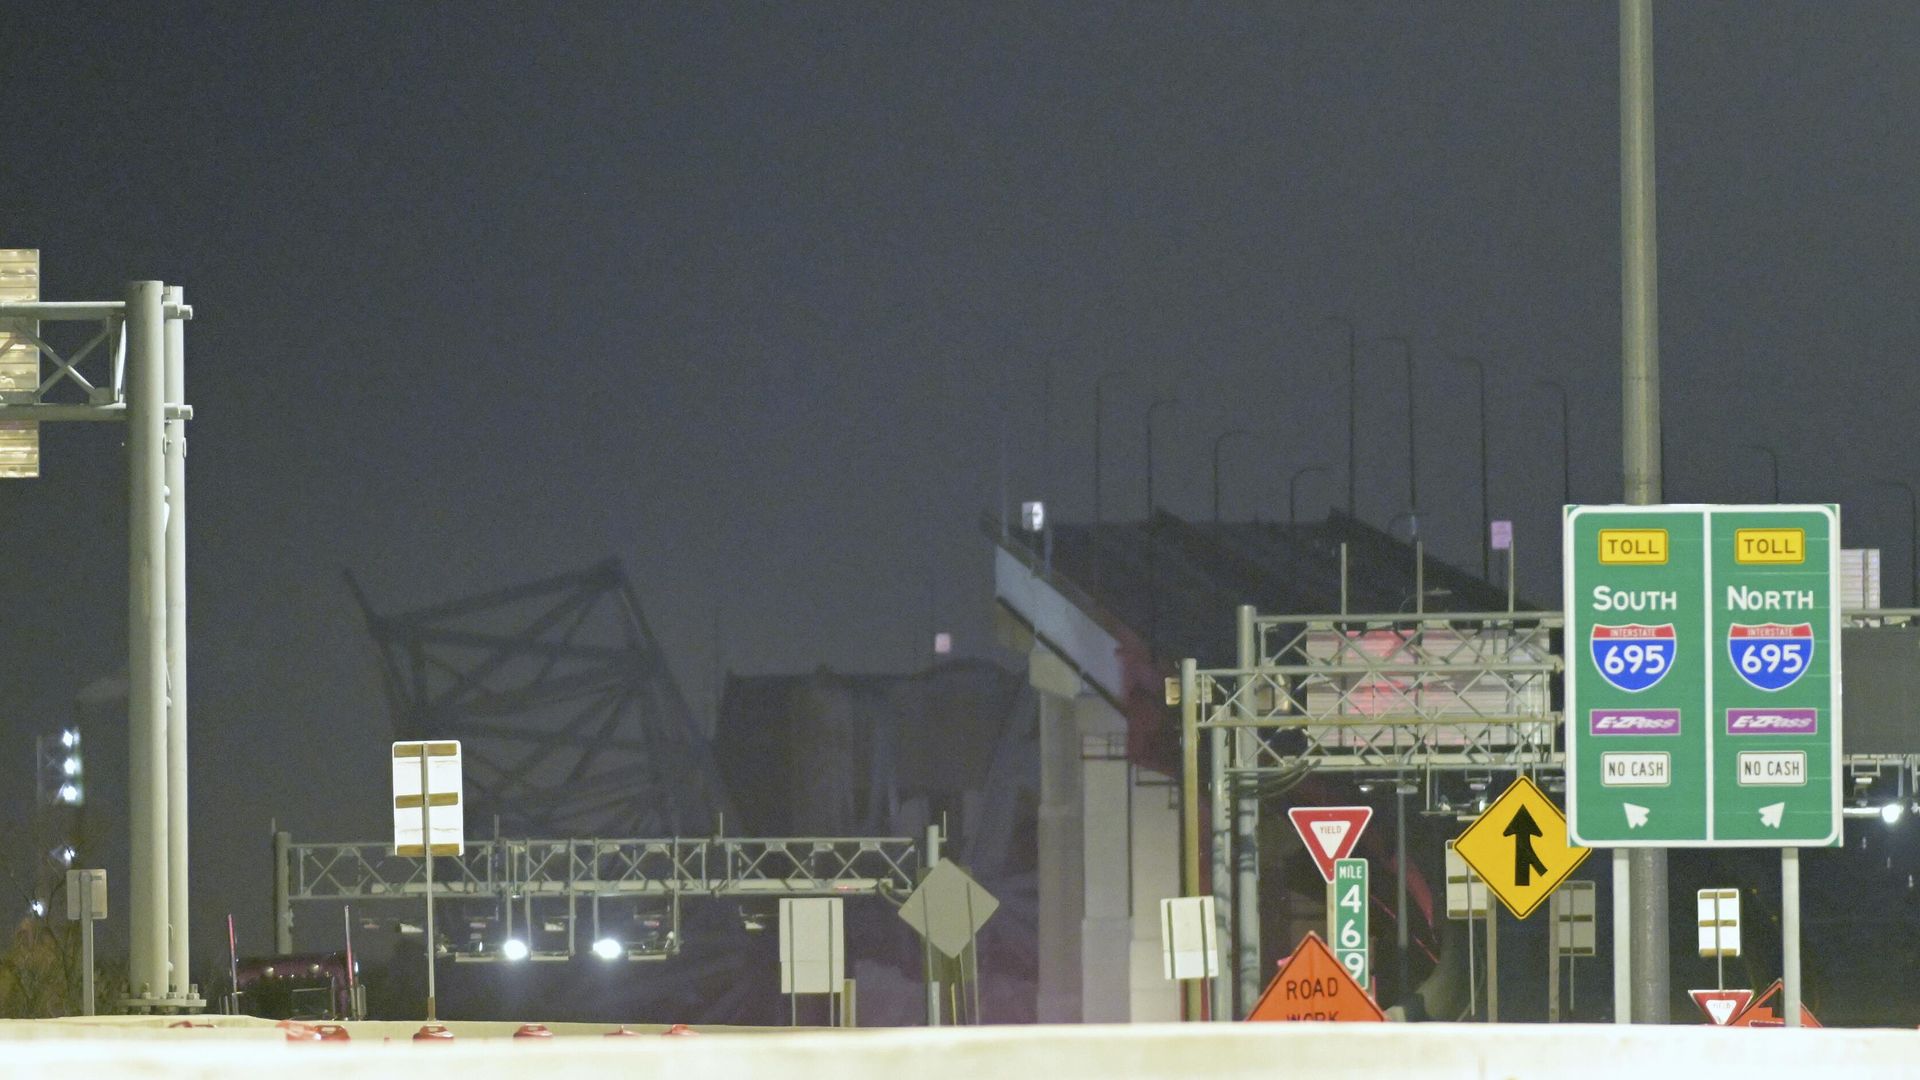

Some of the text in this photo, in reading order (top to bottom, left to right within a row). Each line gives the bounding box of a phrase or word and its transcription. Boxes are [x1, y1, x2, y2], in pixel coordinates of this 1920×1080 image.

[1608, 539, 1659, 554] TOLL
[1744, 538, 1796, 554] TOLL
[1593, 585, 1677, 611] SOUTH
[1727, 585, 1814, 610] NORTH
[1610, 628, 1657, 637] INTERSTATE
[1747, 627, 1793, 637] INTERSTATE
[1604, 644, 1665, 674] 695
[1741, 643, 1803, 674] 695
[1608, 761, 1664, 777] NO CASH
[1744, 760, 1799, 776] NO CASH
[1320, 825, 1342, 834] YIELD
[1339, 865, 1363, 879] MILE
[1286, 977, 1338, 1000] ROAD
